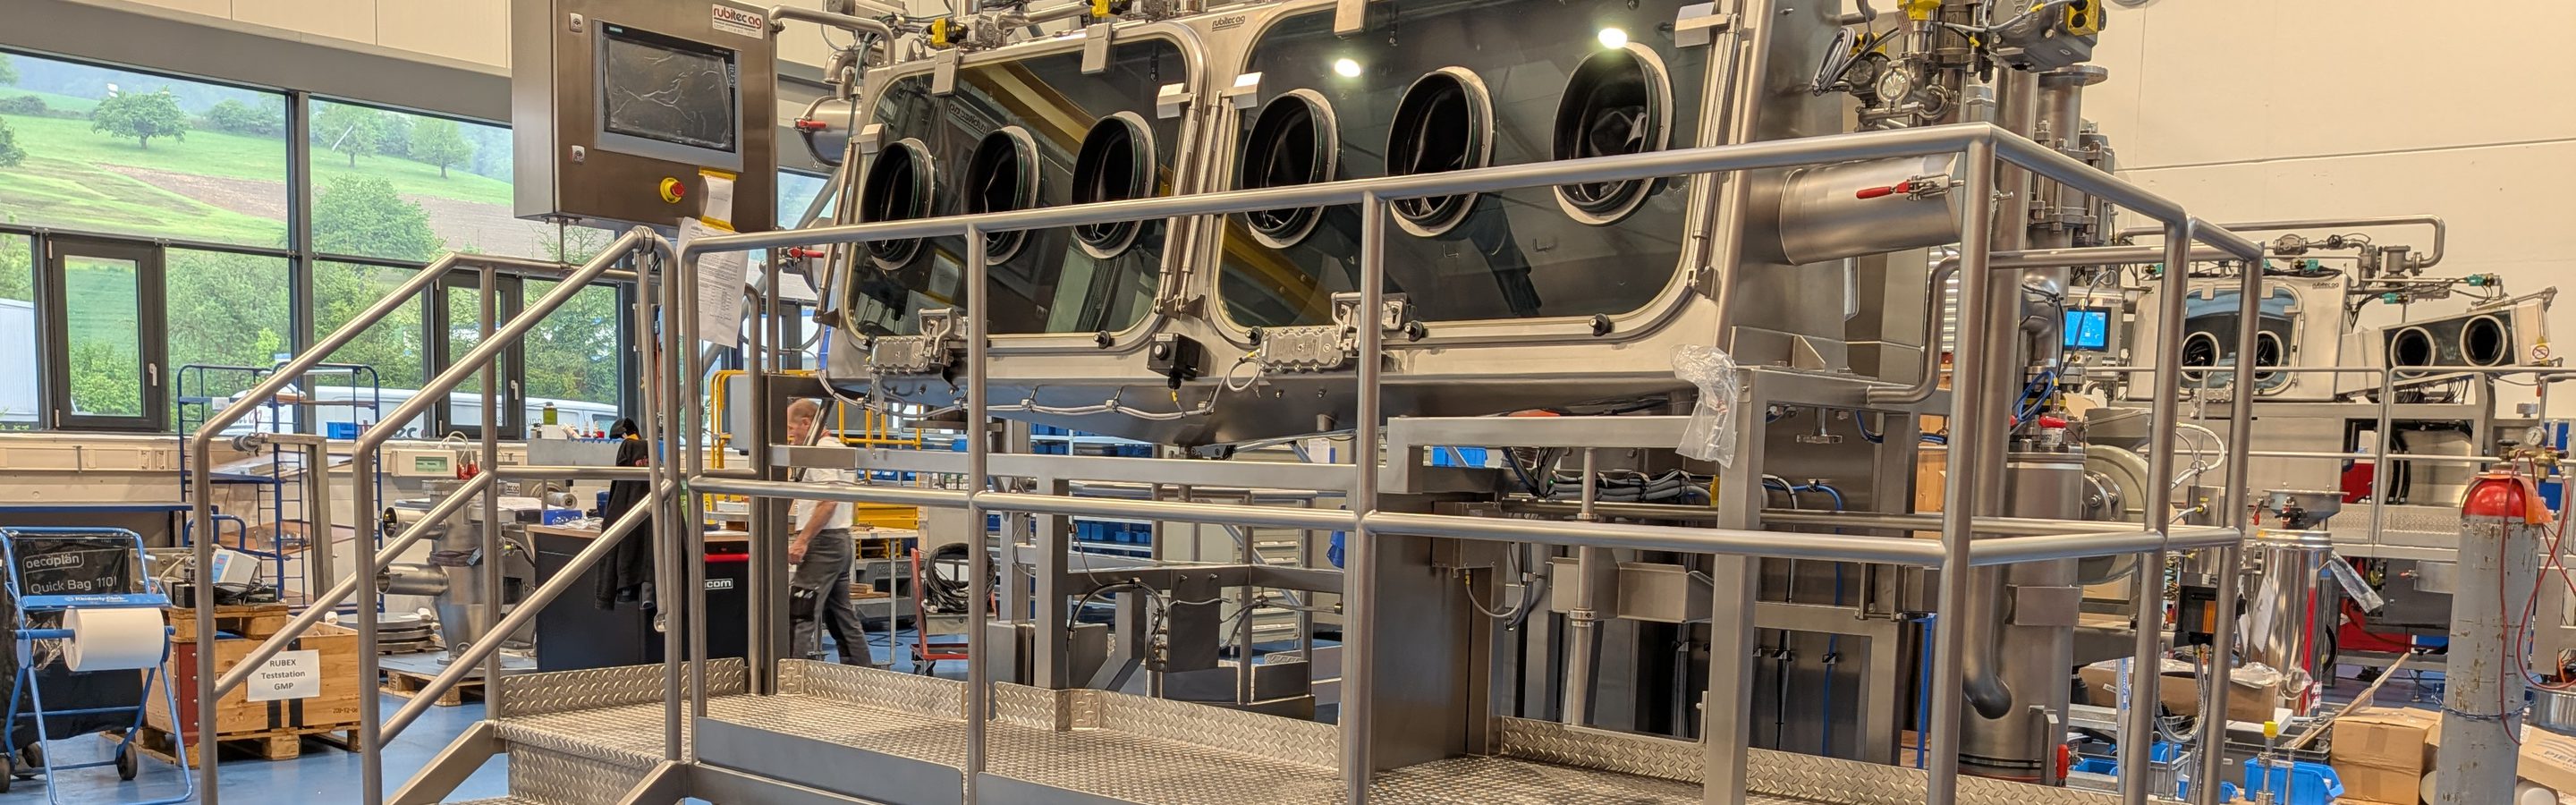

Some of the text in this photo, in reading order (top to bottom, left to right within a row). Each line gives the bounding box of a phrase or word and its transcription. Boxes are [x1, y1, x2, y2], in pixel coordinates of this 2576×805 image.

[713, 7, 748, 23] rubitec
[748, 16, 762, 30] ag
[1212, 14, 1246, 28] rubitec ag
[25, 553, 80, 570] oecoplan
[30, 580, 64, 595] Quick
[67, 580, 92, 591] Bag
[705, 580, 732, 589] com
[269, 658, 297, 668] RUBEX
[260, 670, 306, 680] Teststation
[274, 682, 294, 691] GMP
